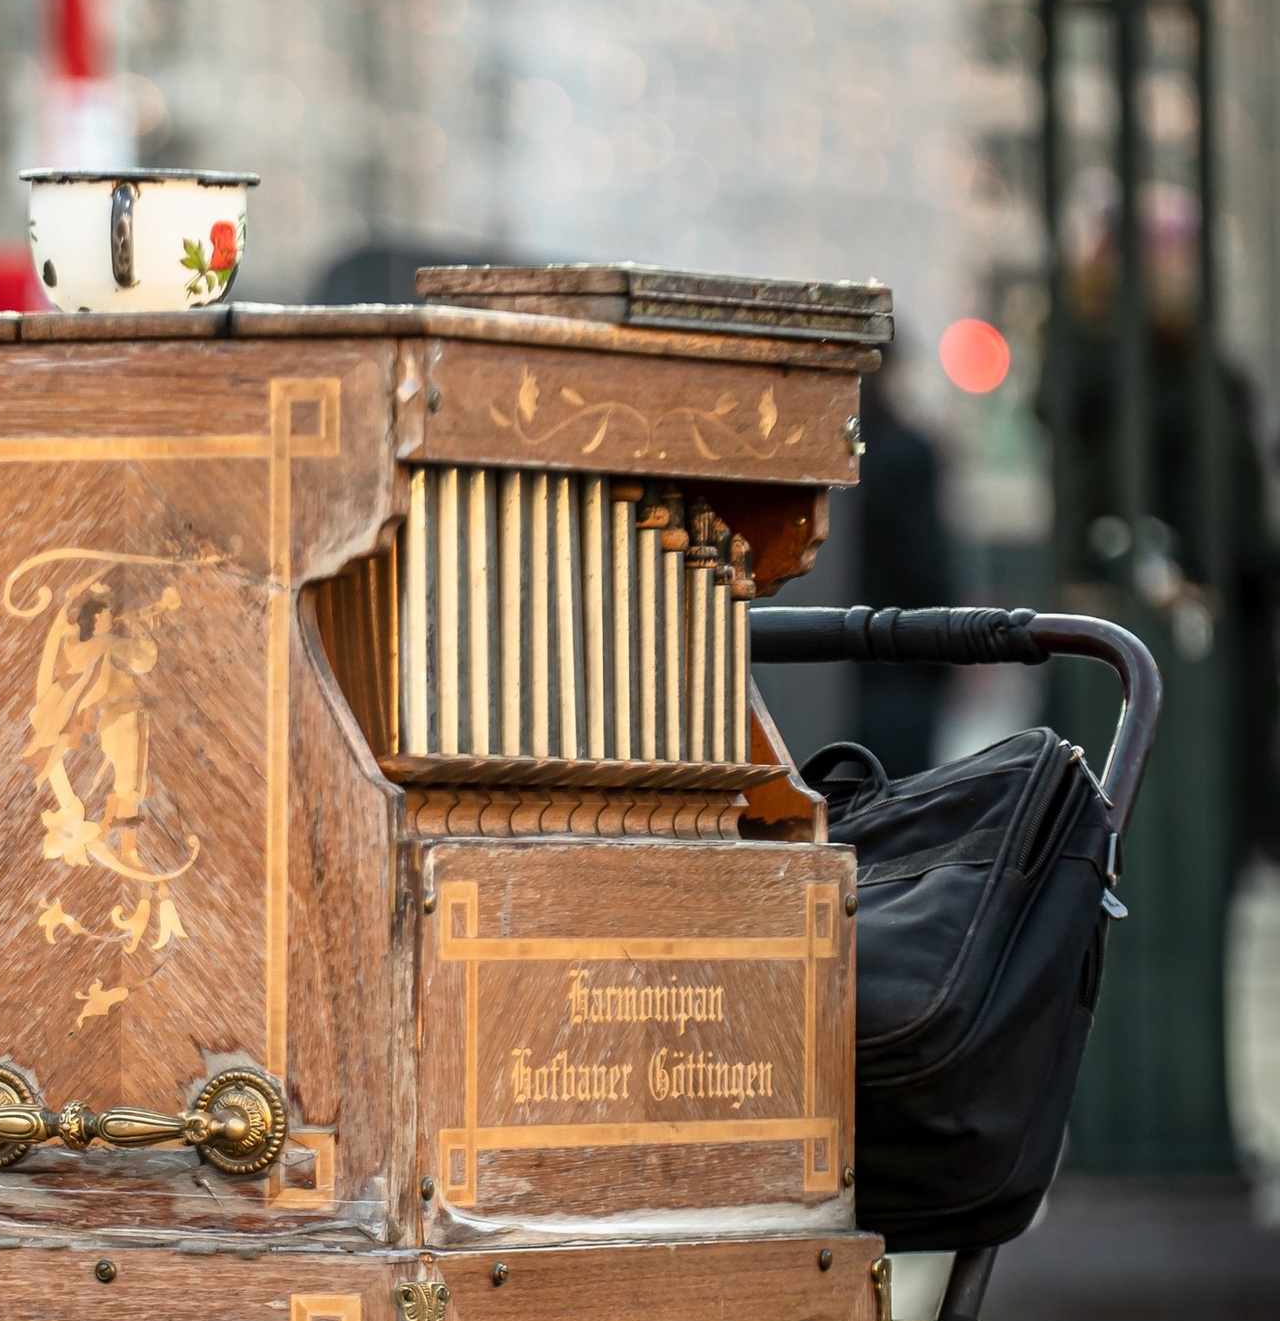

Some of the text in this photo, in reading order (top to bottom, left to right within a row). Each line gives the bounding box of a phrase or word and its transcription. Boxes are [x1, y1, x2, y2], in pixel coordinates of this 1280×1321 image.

[568, 968, 724, 1036] Harmonipan
[511, 1047, 773, 1112] Hofbauer Göttingen
